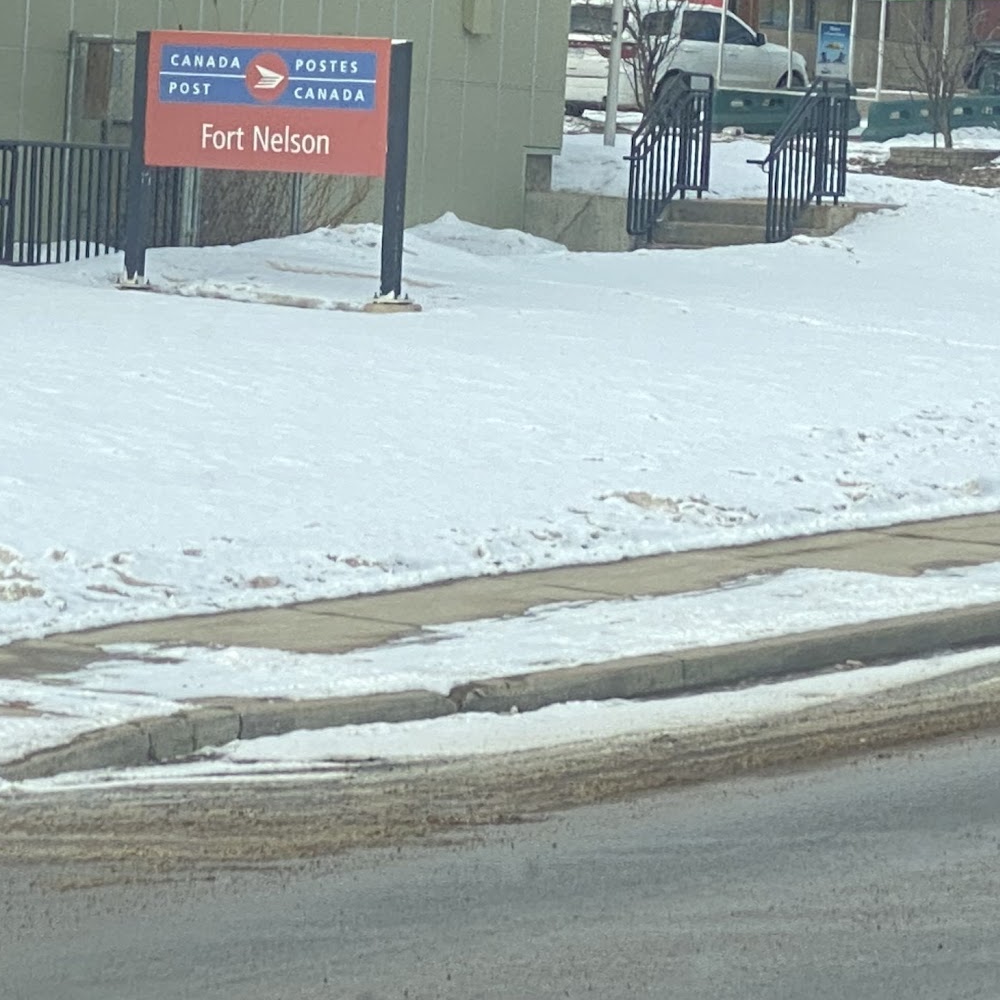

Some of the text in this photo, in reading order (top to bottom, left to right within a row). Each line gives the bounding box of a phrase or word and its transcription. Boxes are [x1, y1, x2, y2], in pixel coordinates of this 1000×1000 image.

[170, 54, 241, 69] CANADA
[295, 58, 359, 74] POSTES
[168, 81, 212, 95] POST
[293, 87, 365, 102] CANADA
[201, 123, 330, 155] Fort Nelson
